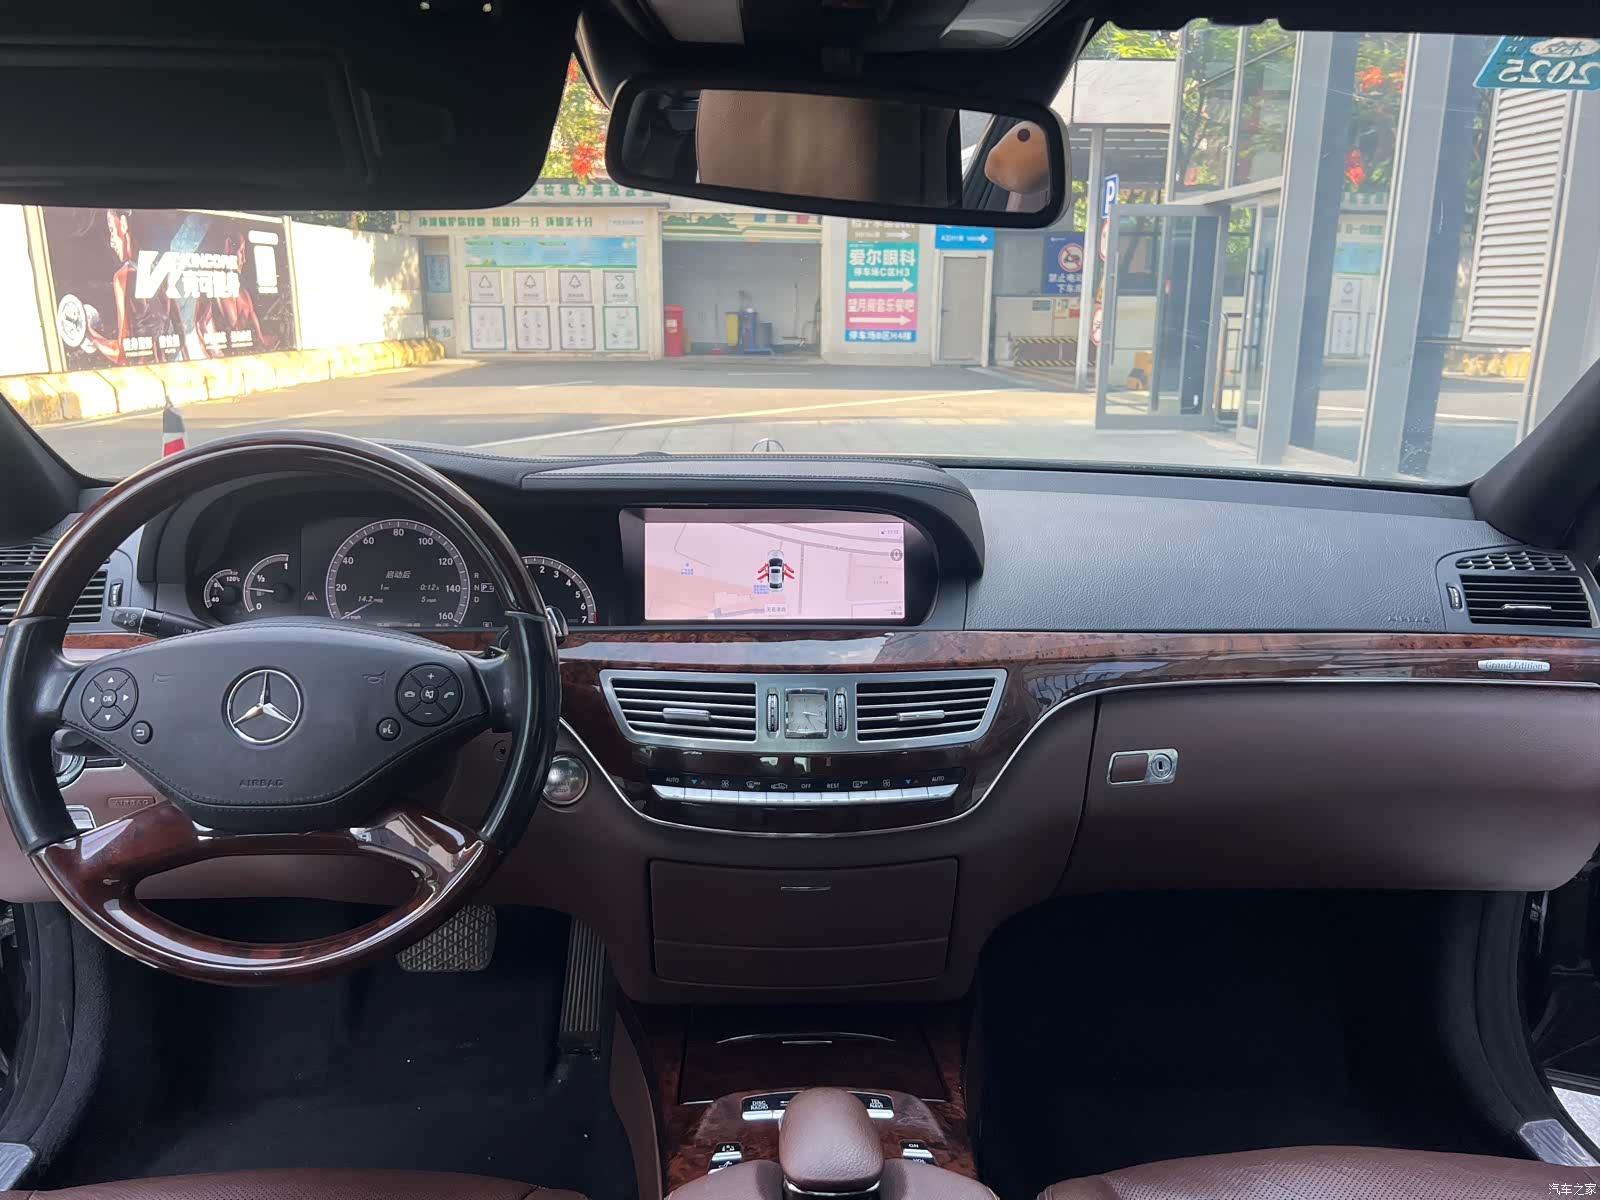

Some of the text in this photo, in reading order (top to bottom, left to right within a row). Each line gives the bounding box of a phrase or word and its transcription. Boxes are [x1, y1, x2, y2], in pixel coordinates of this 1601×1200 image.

[1104, 181, 1116, 214] P
[849, 248, 916, 266] 爱尔眼科
[393, 528, 405, 537] 80
[363, 537, 374, 545] 60
[418, 538, 433, 546] 100
[342, 557, 354, 565] 40
[438, 558, 453, 566] 120
[335, 584, 347, 592] 20
[438, 612, 454, 620] 160
[581, 616, 587, 624] 7
[1485, 661, 1543, 670] Grand Edition
[239, 779, 284, 787] AIRBAG
